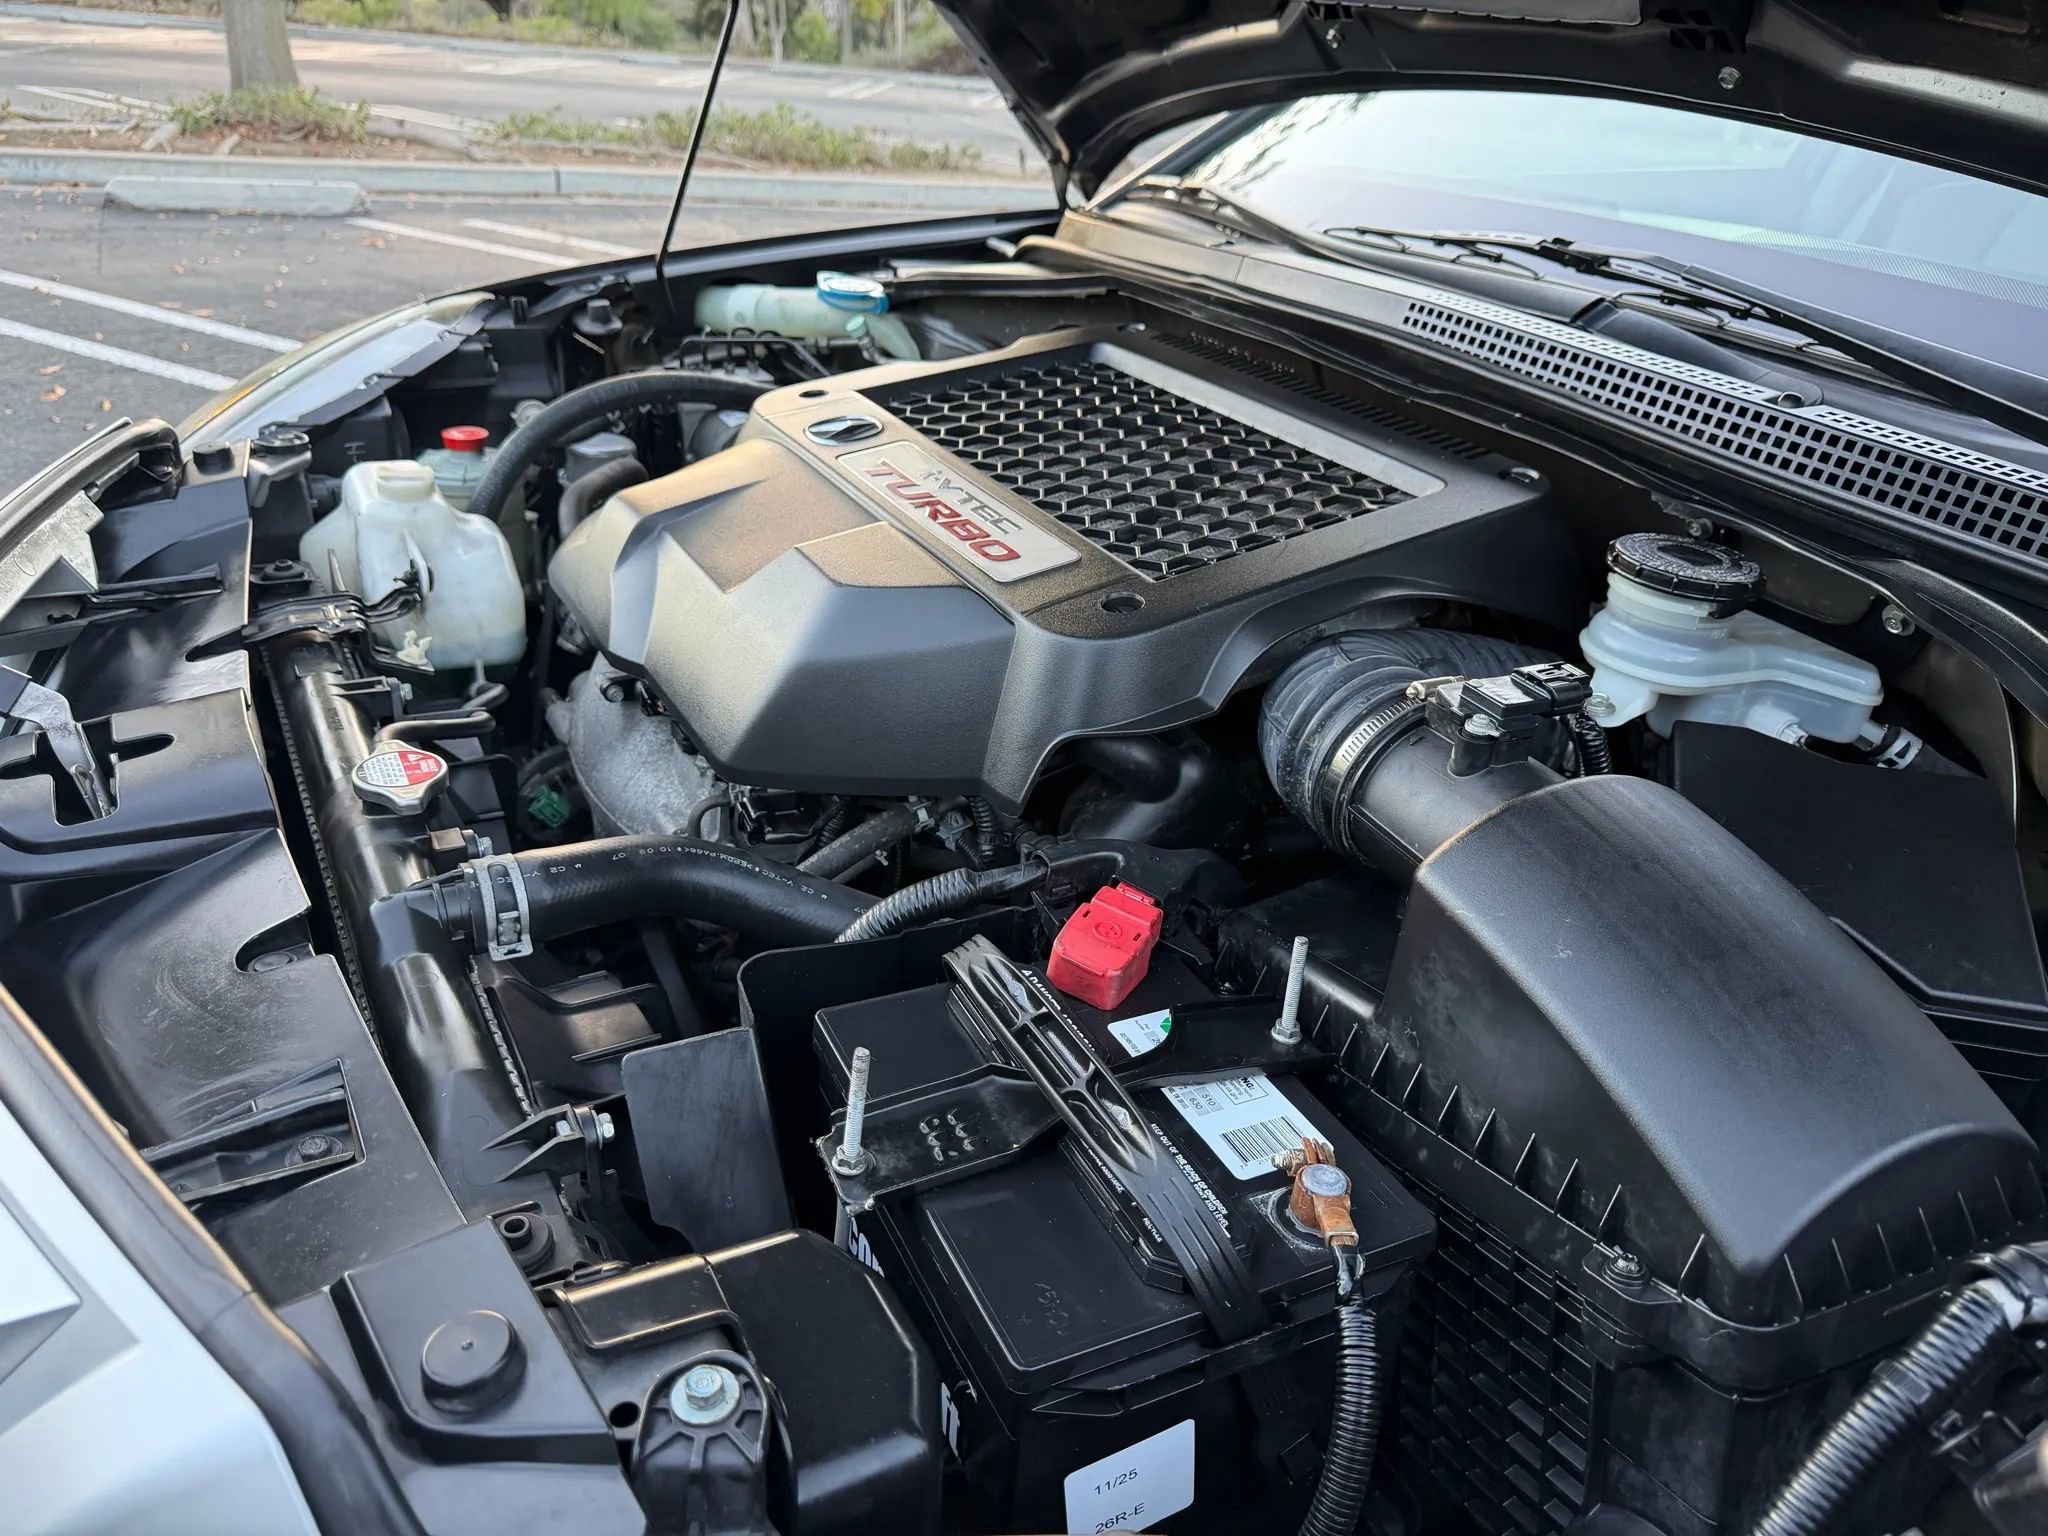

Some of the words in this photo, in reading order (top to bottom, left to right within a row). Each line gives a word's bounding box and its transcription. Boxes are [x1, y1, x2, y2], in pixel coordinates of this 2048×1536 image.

[864, 457, 1022, 562] TURBO
[1189, 1097, 1203, 1110] 630
[1202, 1093, 1216, 1107] 510
[1151, 1123, 1164, 1136] KEEP
[1160, 1135, 1173, 1146] OUT
[1169, 1146, 1180, 1155] OF
[1175, 1154, 1188, 1166] THE
[1204, 1199, 1217, 1212] AND
[1094, 1468, 1138, 1496] 11/25
[1095, 1502, 1145, 1535] 26R-E
